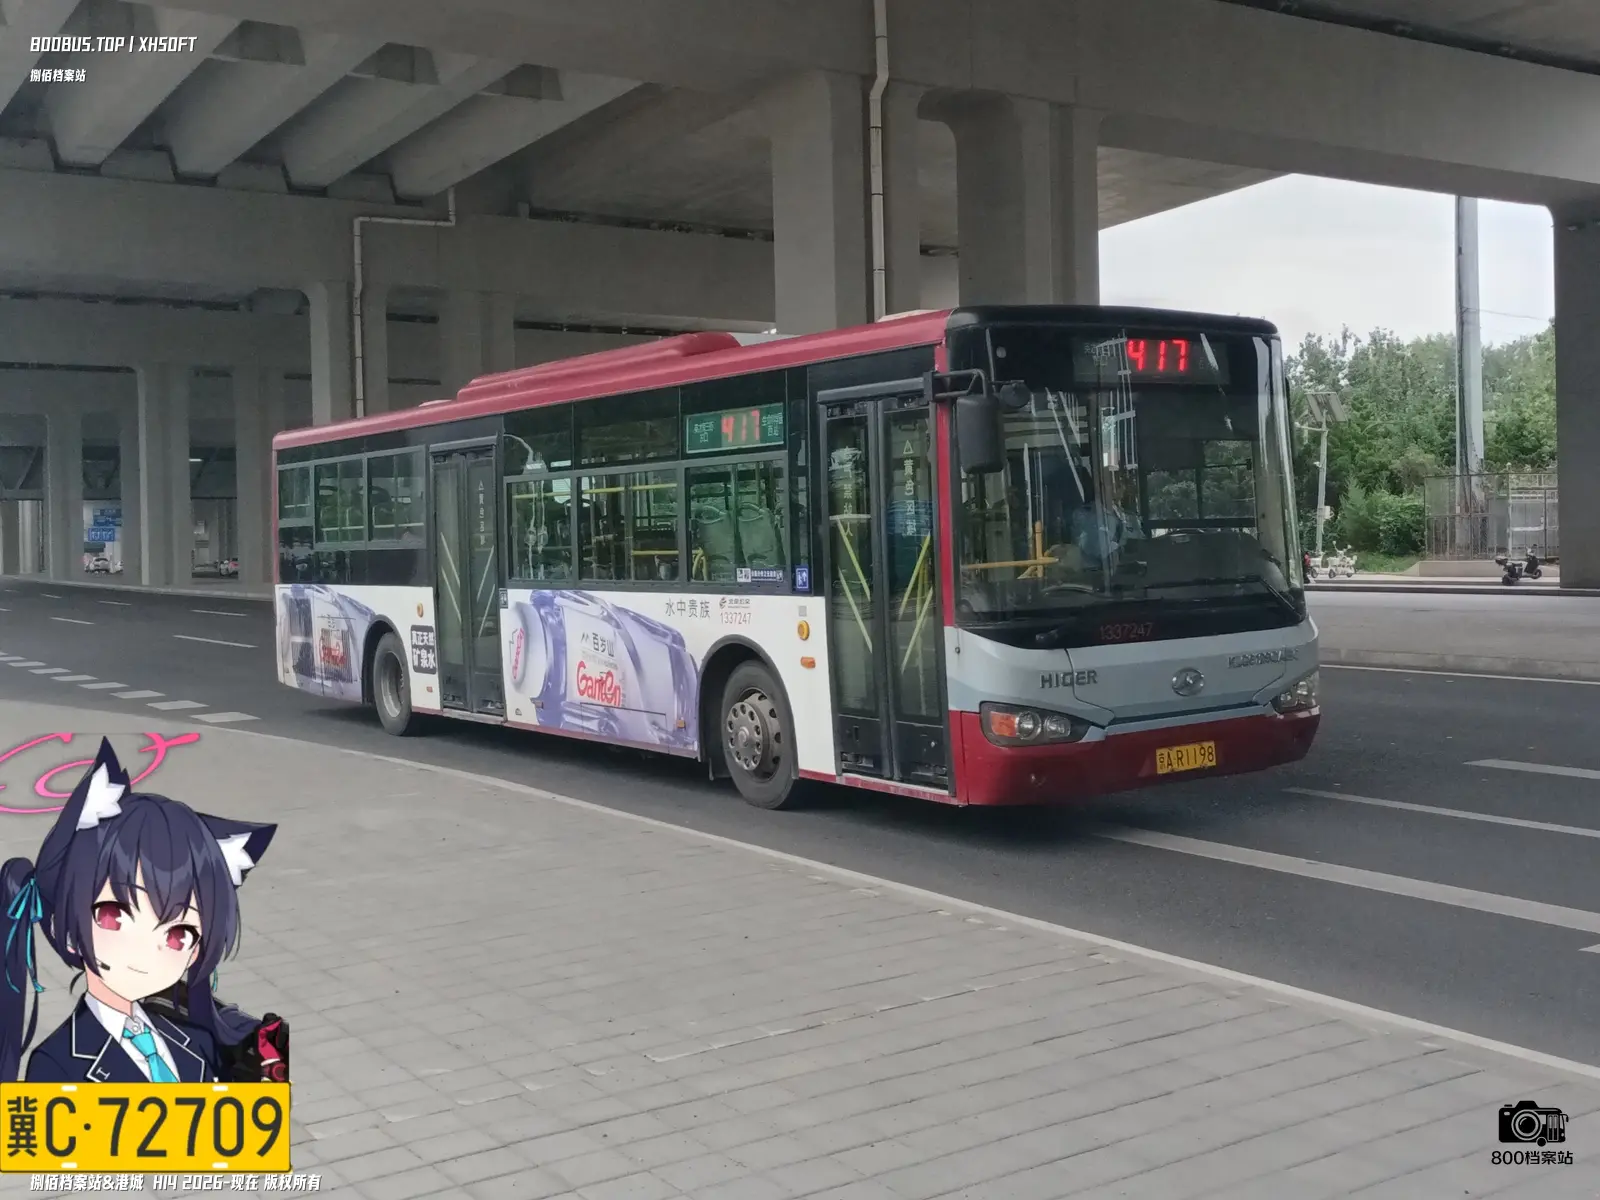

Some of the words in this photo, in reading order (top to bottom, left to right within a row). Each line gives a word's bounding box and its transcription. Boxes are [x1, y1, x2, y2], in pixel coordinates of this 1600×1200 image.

[1127, 339, 1188, 372] 417
[721, 408, 760, 443] 417
[665, 597, 711, 619] 水中贵族
[720, 611, 752, 625] 1337247
[1100, 622, 1153, 640] 1337247
[592, 632, 615, 658] 百岁山
[412, 647, 436, 669] 矿泉水
[1040, 669, 1098, 689] HIGER
